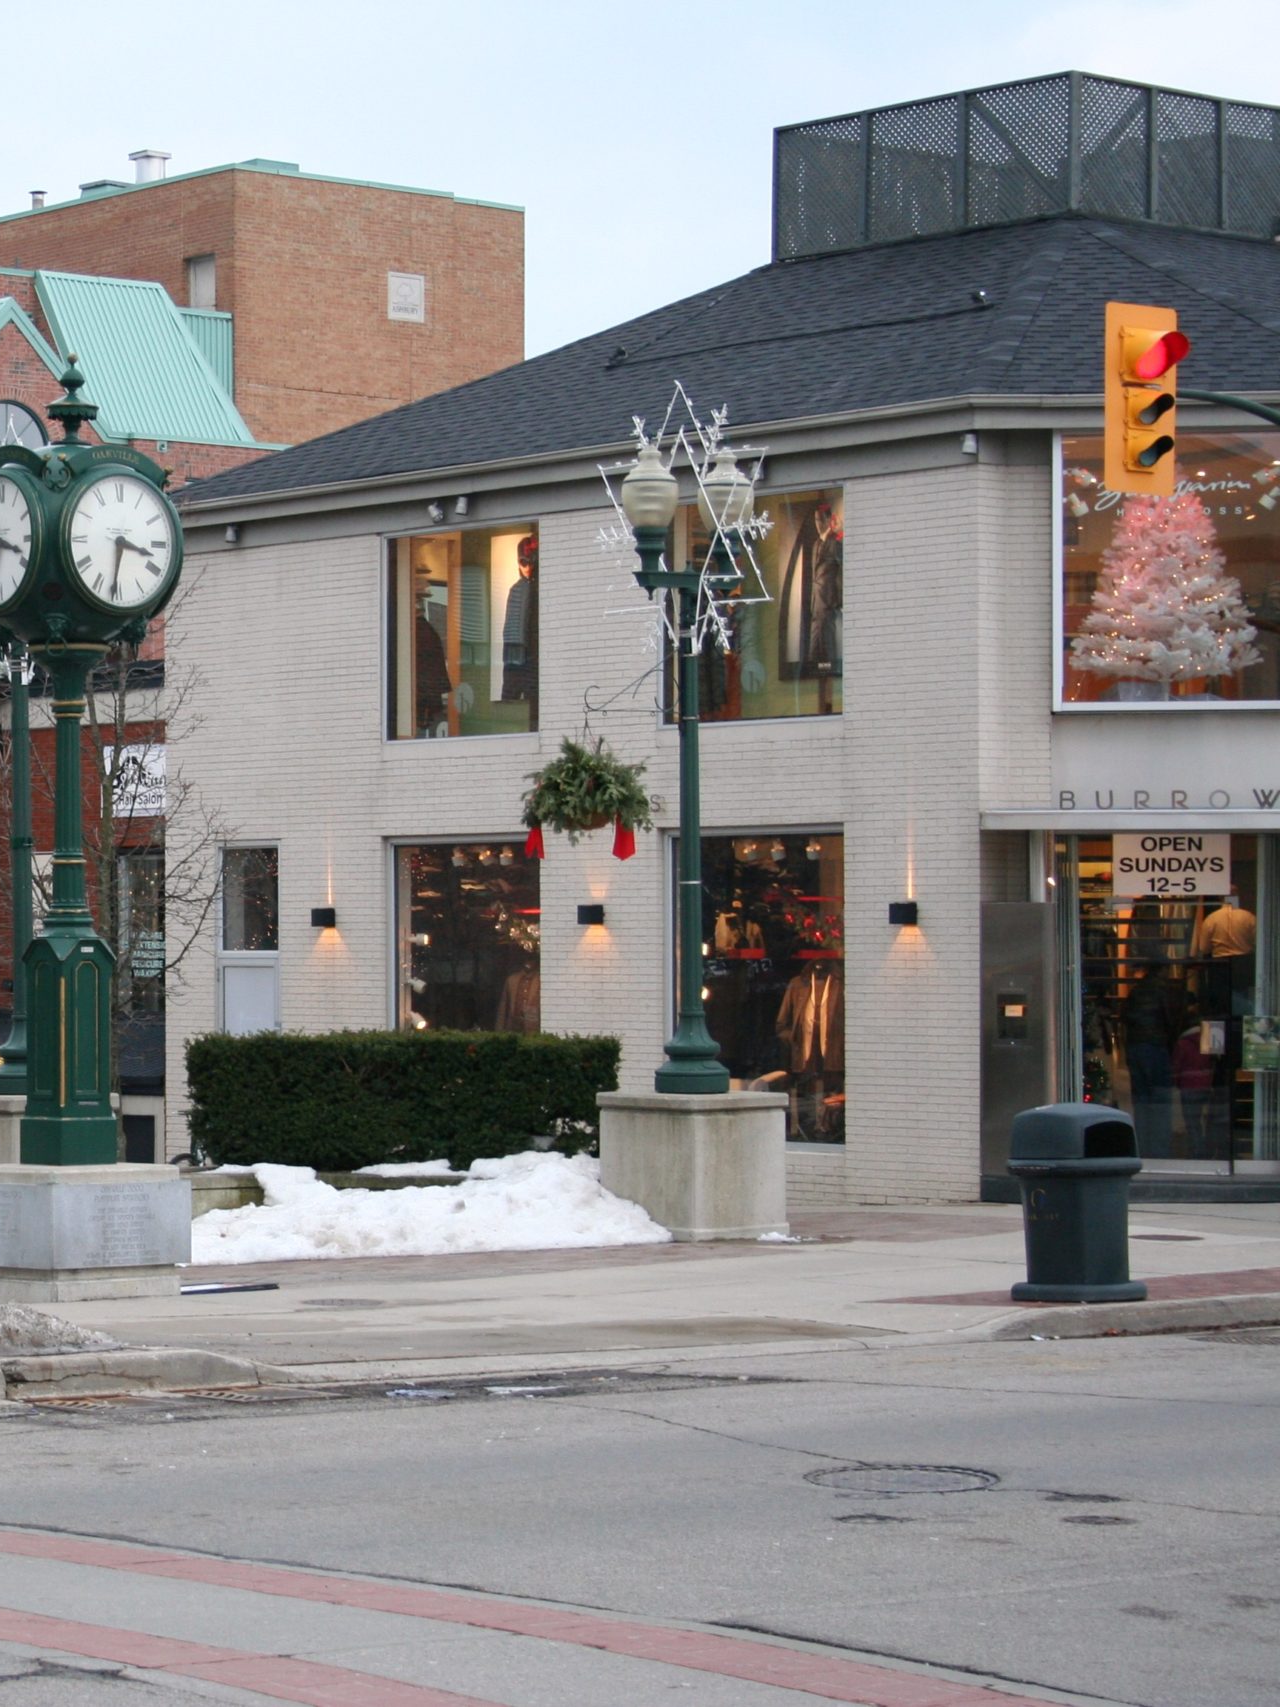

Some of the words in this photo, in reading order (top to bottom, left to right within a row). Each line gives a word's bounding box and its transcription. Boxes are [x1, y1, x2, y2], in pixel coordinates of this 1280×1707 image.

[1187, 506, 1244, 516] BOSS
[139, 792, 162, 804] Salon
[1140, 836, 1202, 852] OPEN
[1119, 856, 1224, 873] SUNDAYS
[1147, 877, 1197, 893] 12-5
